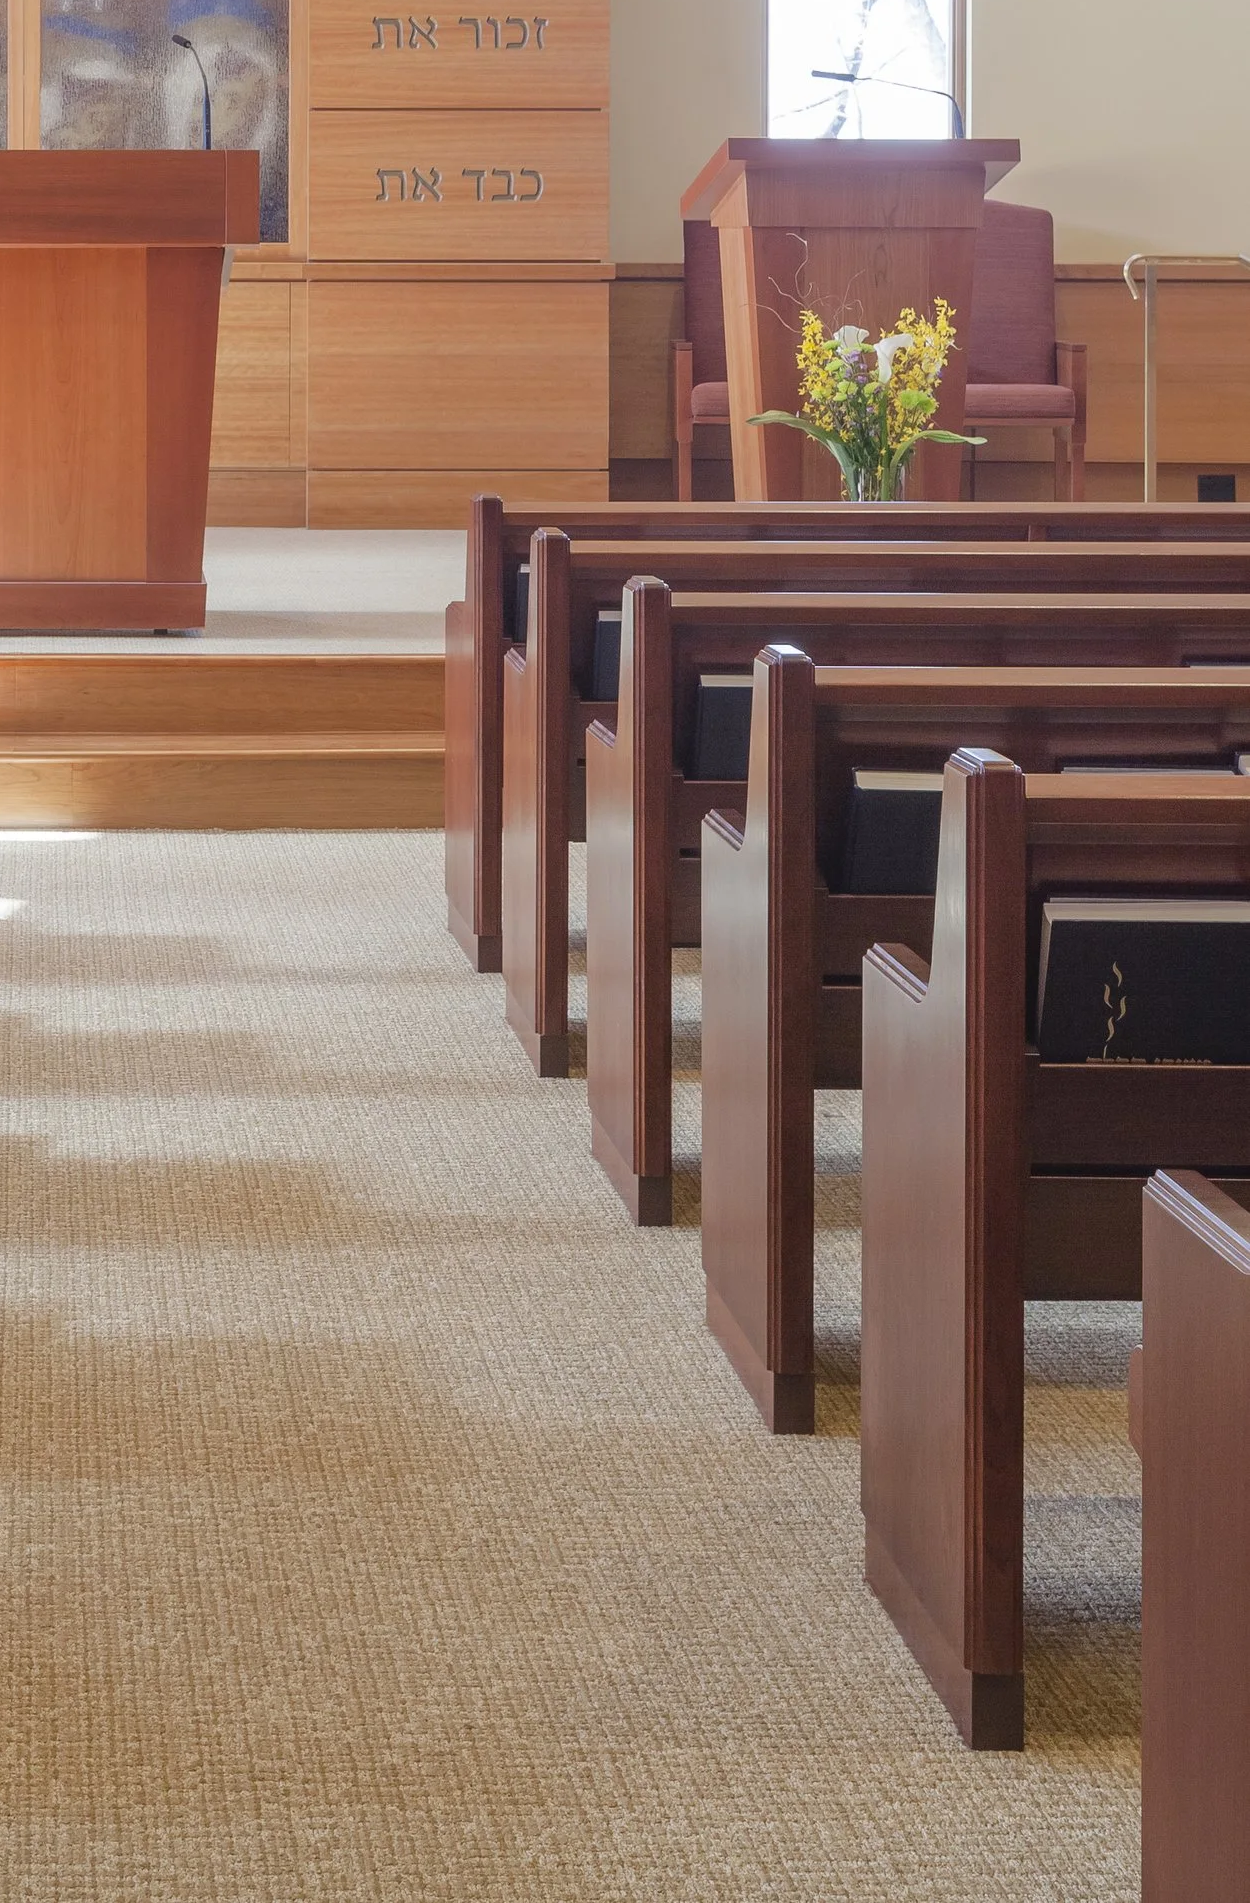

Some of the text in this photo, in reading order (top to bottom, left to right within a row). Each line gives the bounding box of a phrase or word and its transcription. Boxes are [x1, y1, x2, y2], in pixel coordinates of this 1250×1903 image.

[370, 15, 550, 53] זכור את
[374, 165, 546, 203] כבד את
